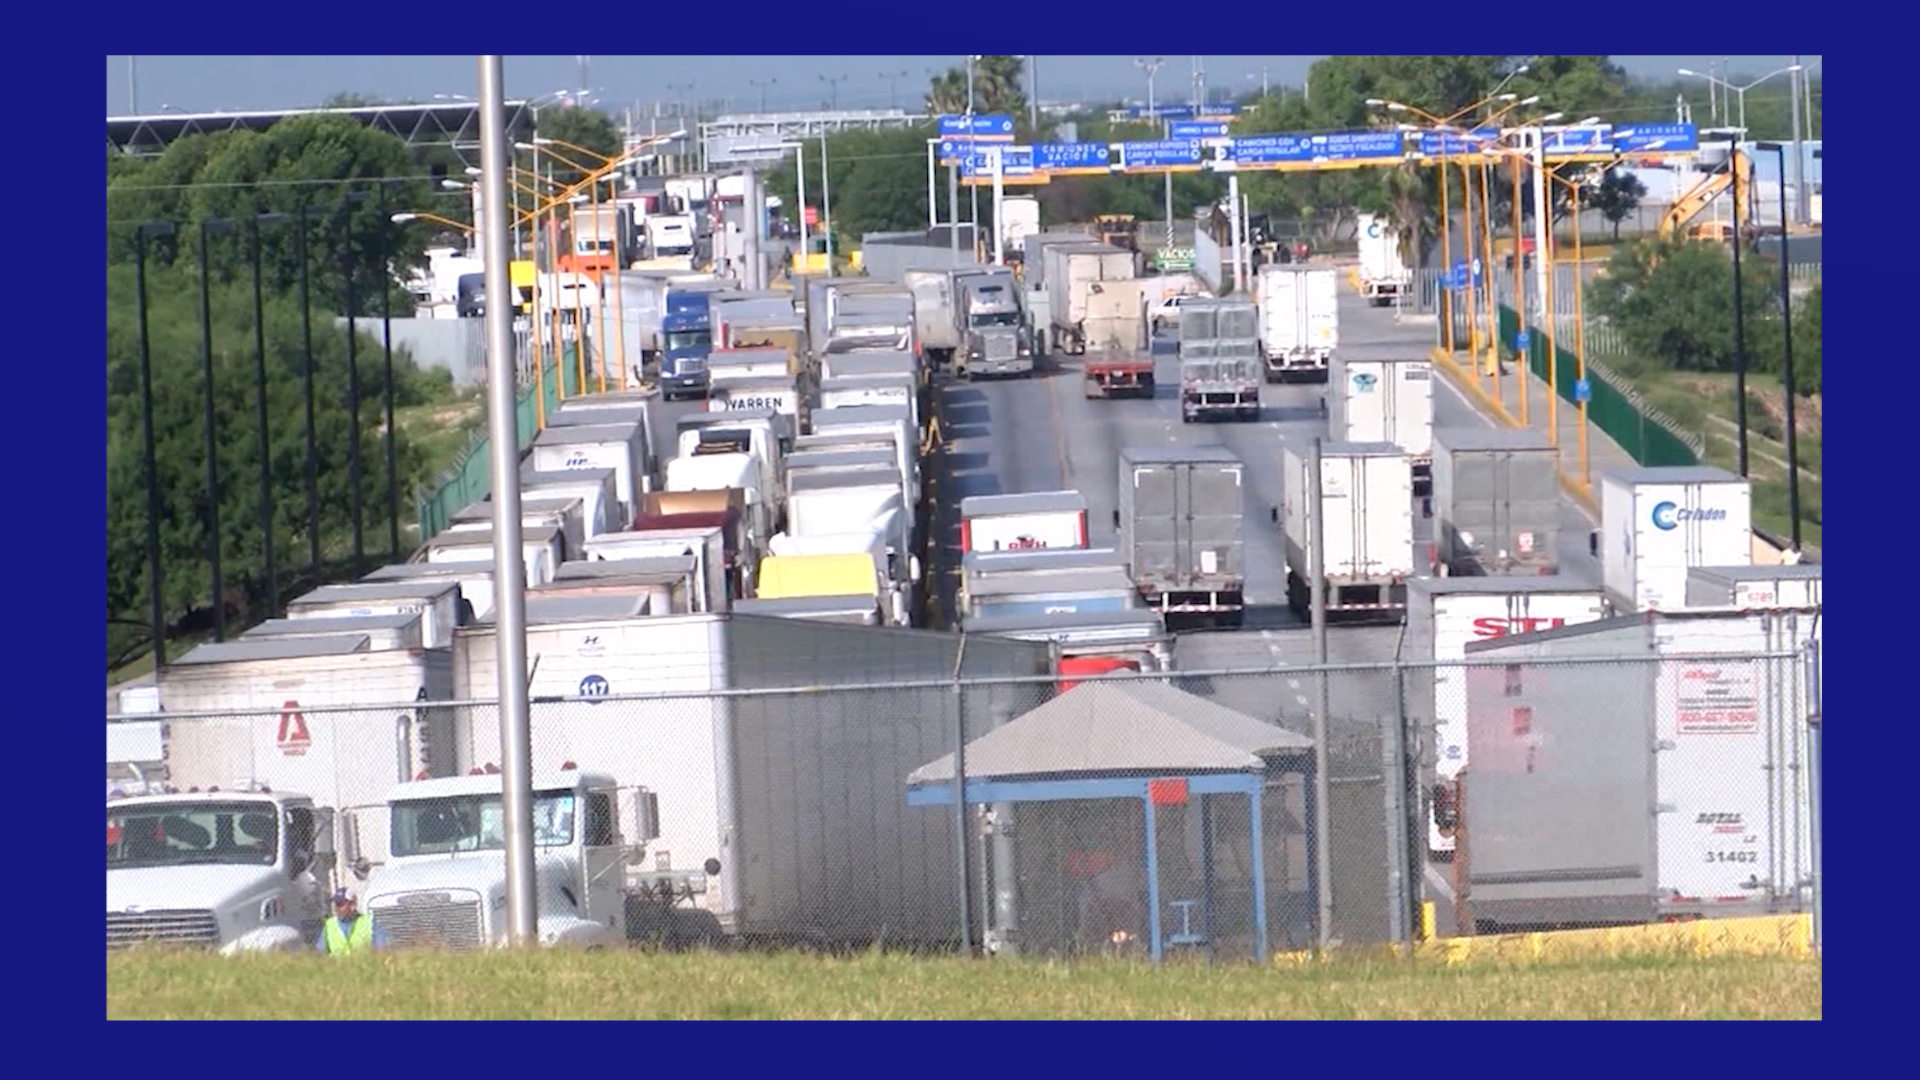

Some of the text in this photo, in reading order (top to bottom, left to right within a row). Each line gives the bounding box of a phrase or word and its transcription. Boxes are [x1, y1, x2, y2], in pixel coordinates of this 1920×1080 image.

[1237, 138, 1277, 147] CAMIONES
[1042, 144, 1097, 154] CAMIONES
[1237, 147, 1264, 156] CARGA
[1048, 152, 1089, 161] VACIOS
[1157, 248, 1195, 259] VACIOS
[581, 682, 607, 697] 117
[1706, 851, 1758, 863] 31402
